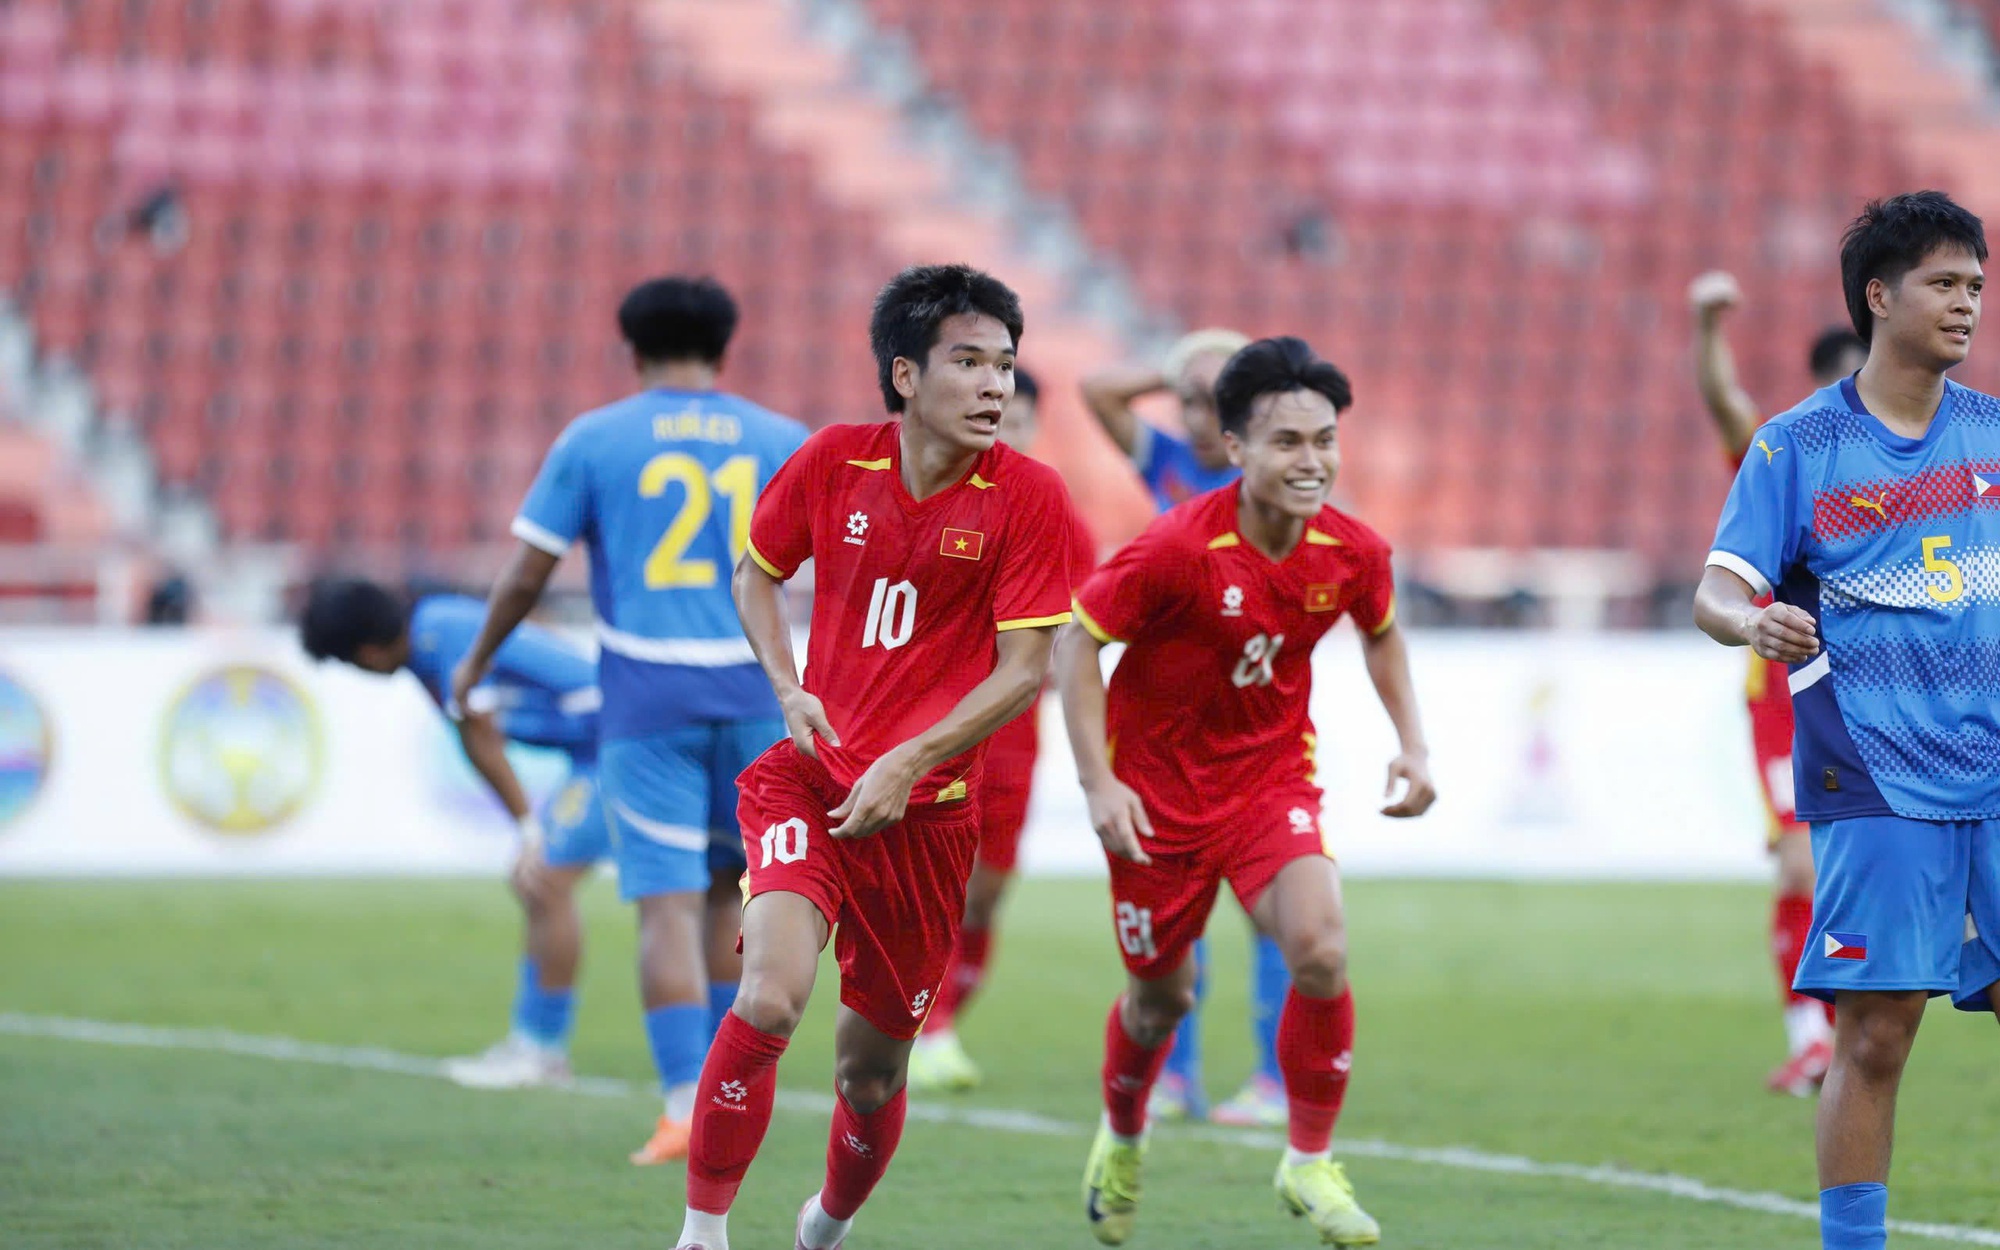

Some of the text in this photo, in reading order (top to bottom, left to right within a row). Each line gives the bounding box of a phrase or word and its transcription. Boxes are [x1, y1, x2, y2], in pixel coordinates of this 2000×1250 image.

[637, 451, 759, 591] 21
[1921, 535, 1964, 602] 5
[862, 577, 918, 650] 10
[1231, 632, 1286, 688] 21
[760, 817, 808, 869] 10
[1117, 901, 1157, 959] 21
